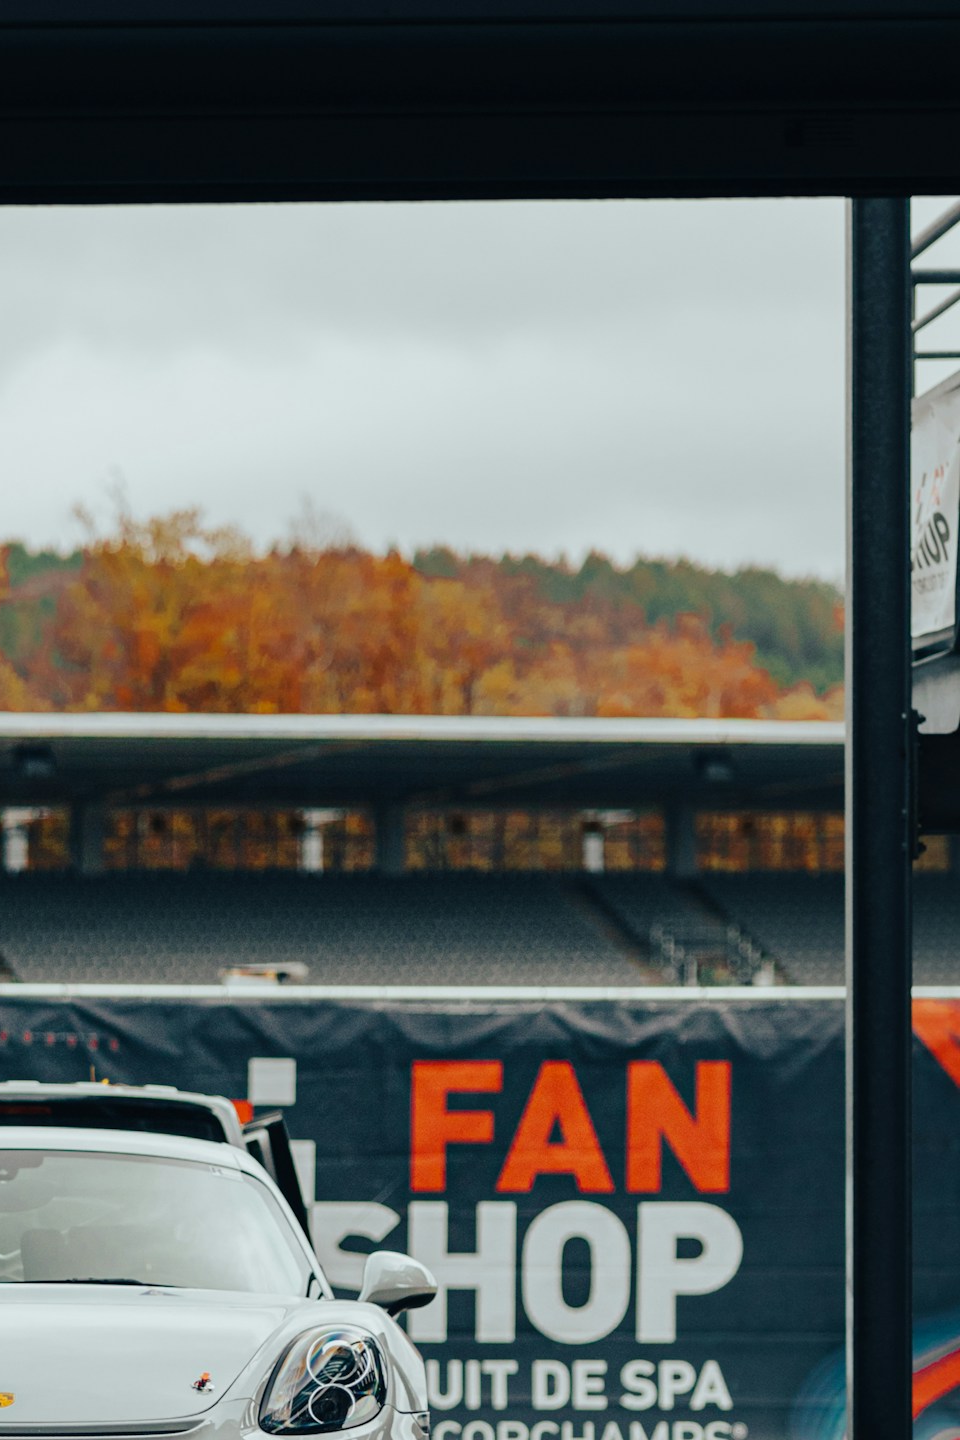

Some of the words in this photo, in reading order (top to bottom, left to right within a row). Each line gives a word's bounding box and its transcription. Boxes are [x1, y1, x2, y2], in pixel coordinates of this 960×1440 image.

[411, 1060, 732, 1193] FAN
[311, 1200, 744, 1344] SHOP
[532, 1360, 608, 1411] DE
[621, 1360, 733, 1411] SPA
